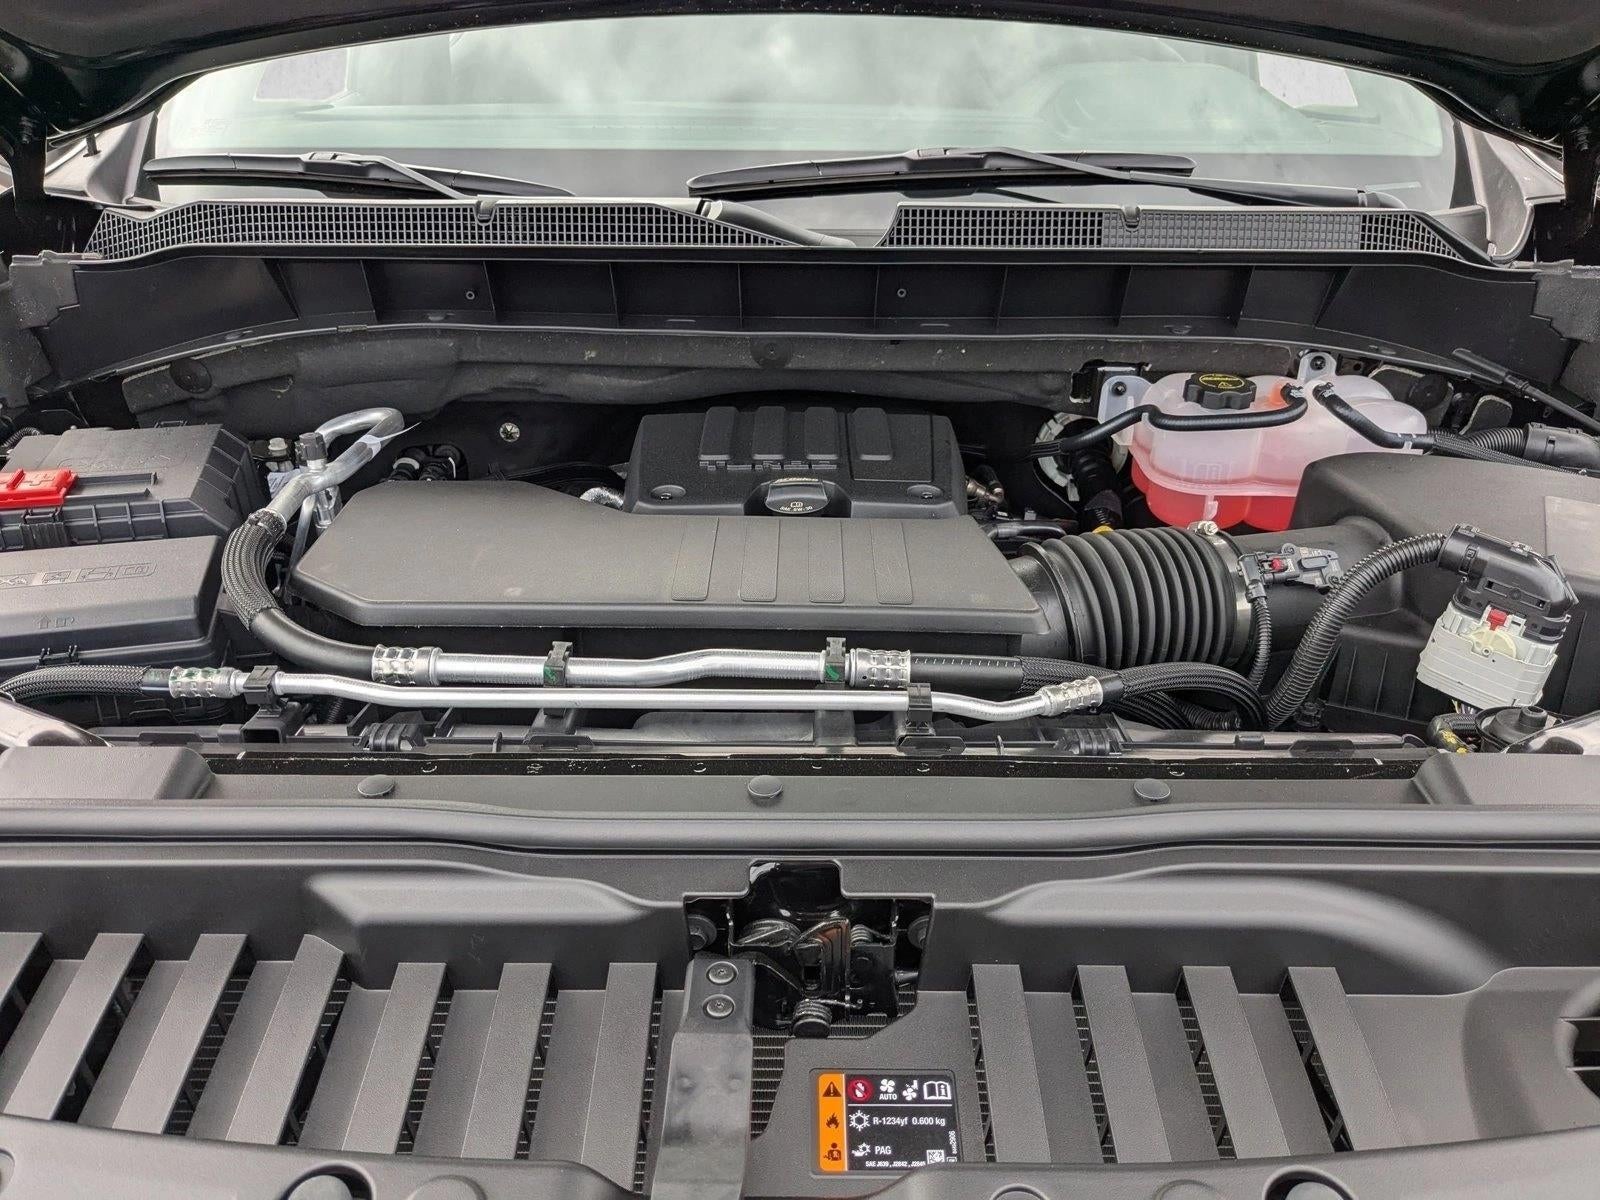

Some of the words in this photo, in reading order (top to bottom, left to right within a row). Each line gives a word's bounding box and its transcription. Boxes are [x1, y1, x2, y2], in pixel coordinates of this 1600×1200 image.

[879, 1093, 898, 1101] AUTO
[873, 1117, 908, 1127] R-1234yf
[912, 1117, 934, 1125] 0.600
[935, 1117, 946, 1127] kg
[875, 1146, 892, 1155] PAG
